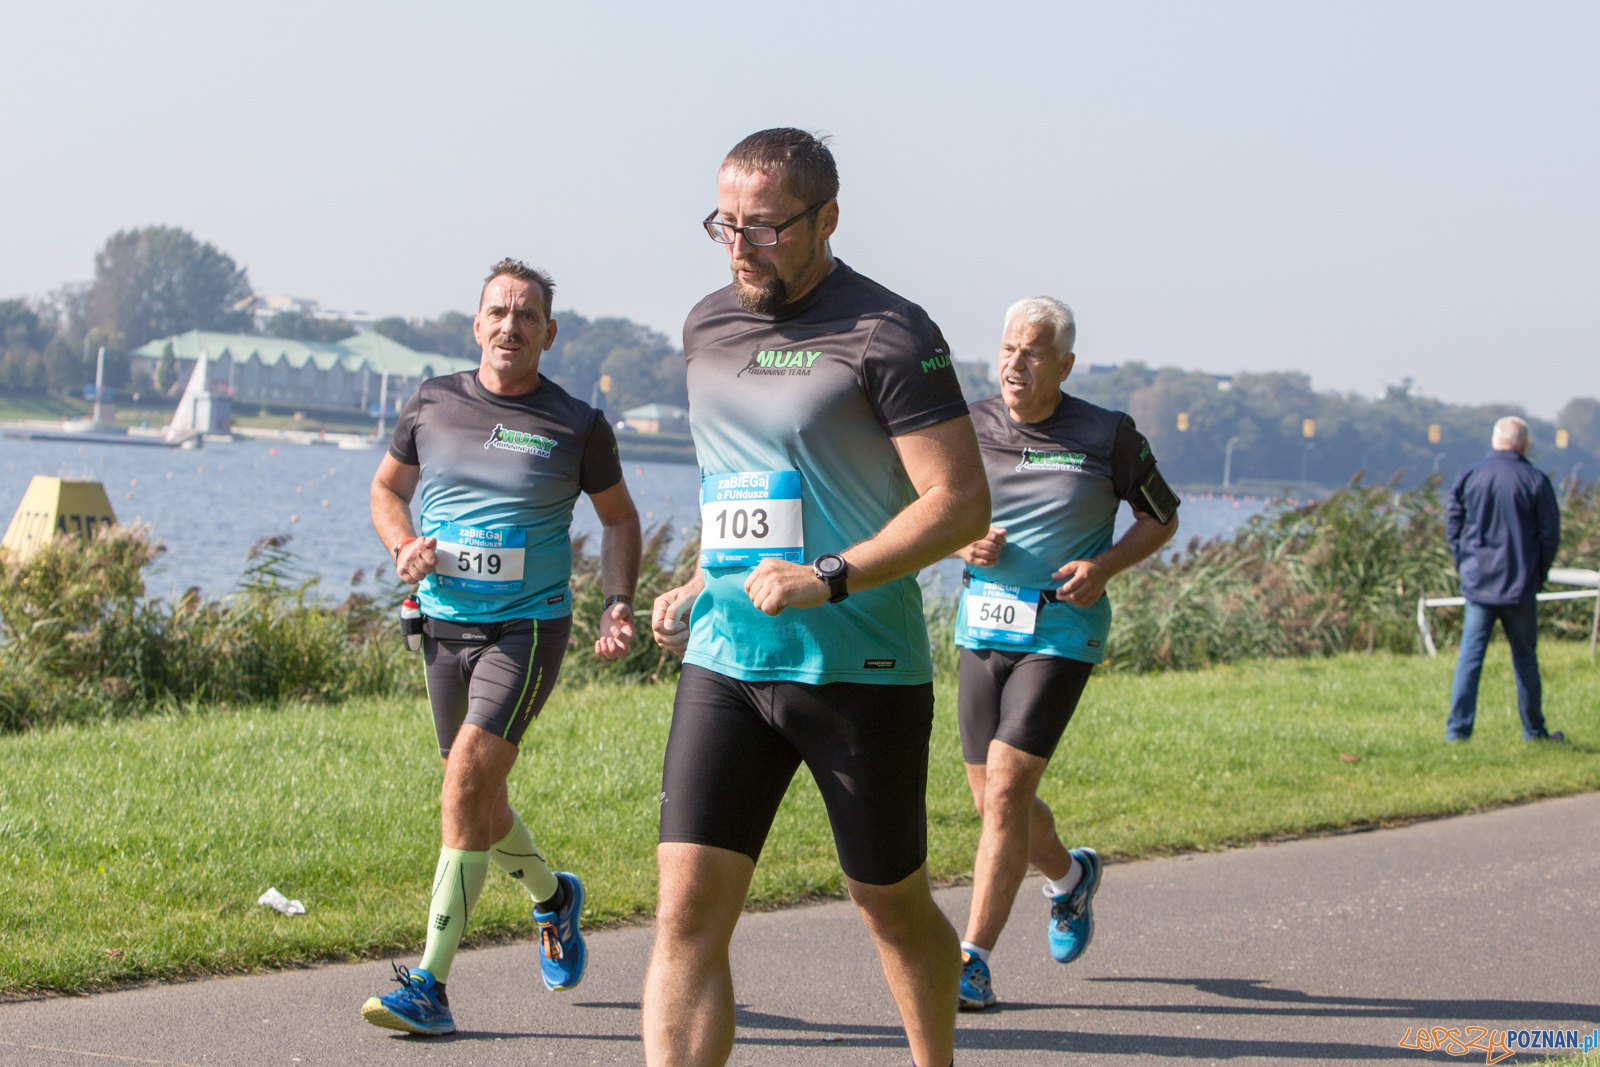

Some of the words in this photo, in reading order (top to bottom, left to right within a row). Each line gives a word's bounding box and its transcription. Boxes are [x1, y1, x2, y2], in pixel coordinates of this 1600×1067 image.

[756, 350, 823, 368] MUAY
[751, 368, 787, 376] RUNNING
[788, 368, 811, 376] TEAM
[498, 429, 557, 452] MUAY
[496, 441, 528, 453] RUNNING
[529, 446, 550, 458] TEAM
[1028, 451, 1086, 466] MUAY
[717, 474, 770, 490] zaBIEGaj
[716, 492, 723, 500] o
[723, 490, 769, 500] FUNdusze
[715, 508, 770, 539] 103
[459, 528, 503, 542] zaBIEGaj
[464, 538, 503, 548] FUNdusze
[457, 551, 502, 575] 519
[979, 602, 1016, 625] 540
